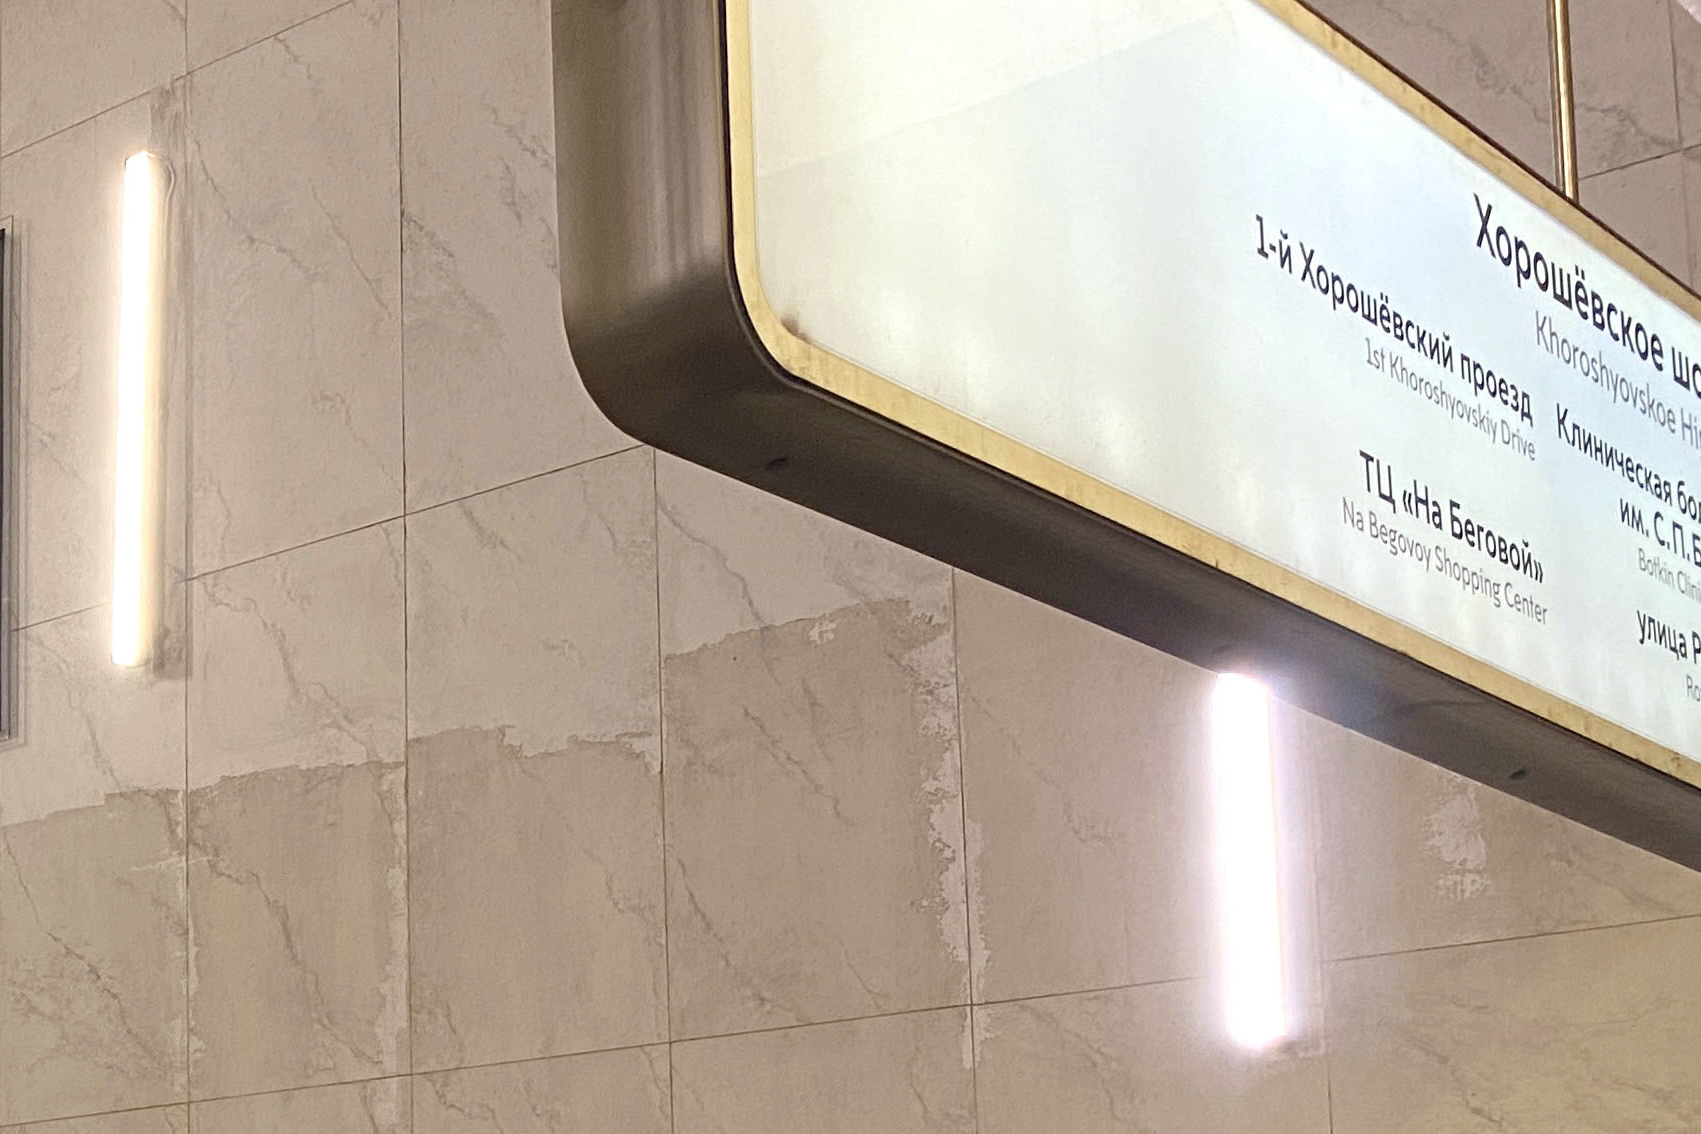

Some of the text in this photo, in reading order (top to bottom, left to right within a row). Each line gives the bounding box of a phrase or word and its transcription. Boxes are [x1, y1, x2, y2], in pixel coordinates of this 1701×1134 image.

[1255, 214, 1534, 428] 1-й Хорошёвский проезд
[1473, 192, 1664, 371] Хорошёвское
[1365, 337, 1536, 461] 1st Khoroshyovskiy Drive
[1535, 309, 1701, 451] Khoroshyovskoe Hi
[1359, 449, 1544, 583] ТЦ «На Беговой»
[1557, 403, 1701, 524] Клиническая бо
[1619, 498, 1649, 538] им.
[1342, 497, 1548, 625] Na Begovoy Shopping Center
[1639, 547, 1674, 588] Botkin
[1636, 609, 1687, 661] улица
